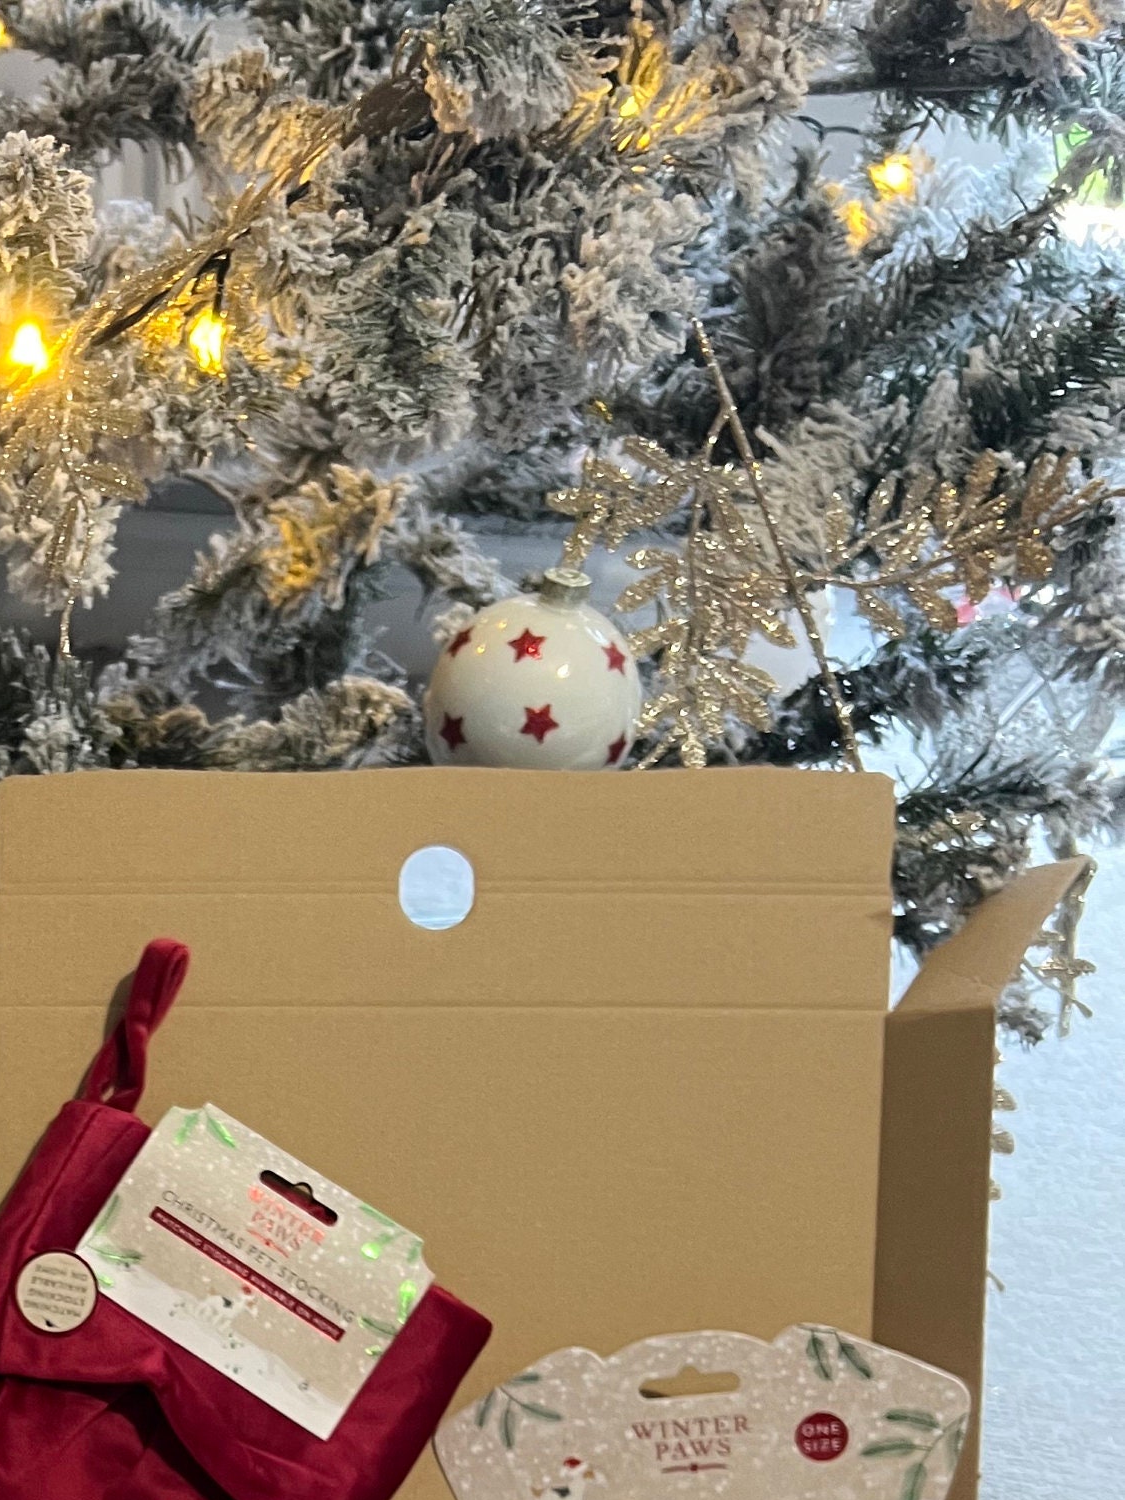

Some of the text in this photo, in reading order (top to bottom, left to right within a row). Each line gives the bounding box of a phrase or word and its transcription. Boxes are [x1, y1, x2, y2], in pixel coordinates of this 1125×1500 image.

[251, 1210, 301, 1250] PAWS
[161, 1189, 355, 1323] CHRISTMAS PET STOCKING
[631, 1414, 751, 1440] WINTER
[801, 1421, 842, 1438] ONE
[655, 1437, 732, 1461] PAWS
[802, 1437, 842, 1452] SIZE
